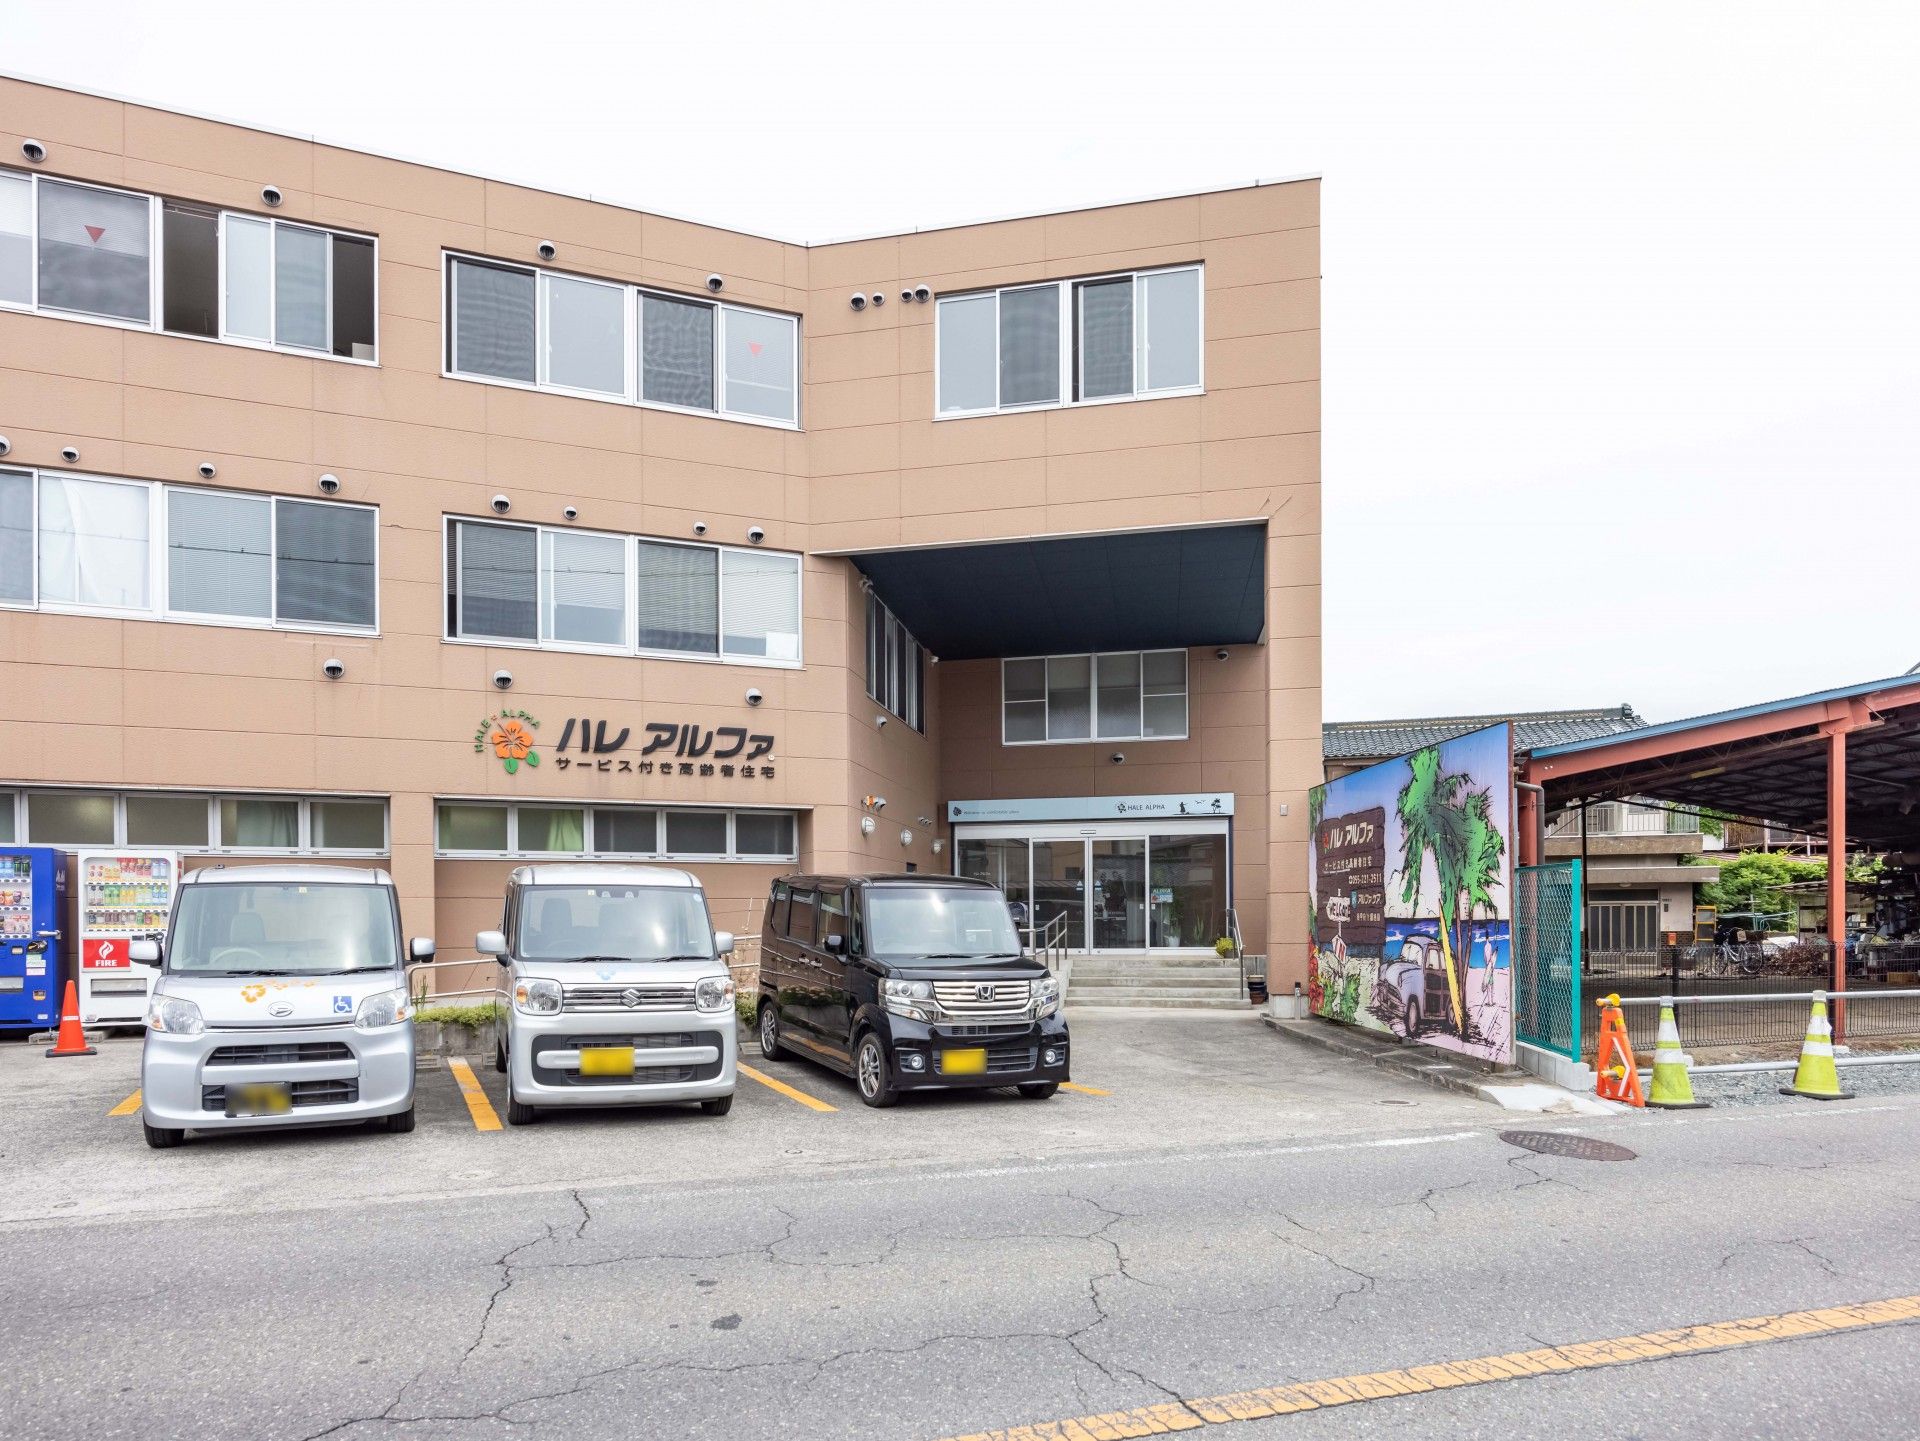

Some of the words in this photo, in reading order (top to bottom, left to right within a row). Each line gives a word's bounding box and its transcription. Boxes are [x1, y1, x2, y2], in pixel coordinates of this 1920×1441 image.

[474, 719, 491, 753] HALE
[501, 708, 540, 729] ALPHA
[556, 717, 630, 754] ハレ
[641, 722, 774, 760] アルファ
[555, 756, 775, 779] サービス付き高齢者住宅
[1145, 803, 1166, 811] ALPHA
[1329, 827, 1344, 850] ハレ
[1344, 821, 1374, 846] アルファ
[95, 959, 118, 967] FIRE
